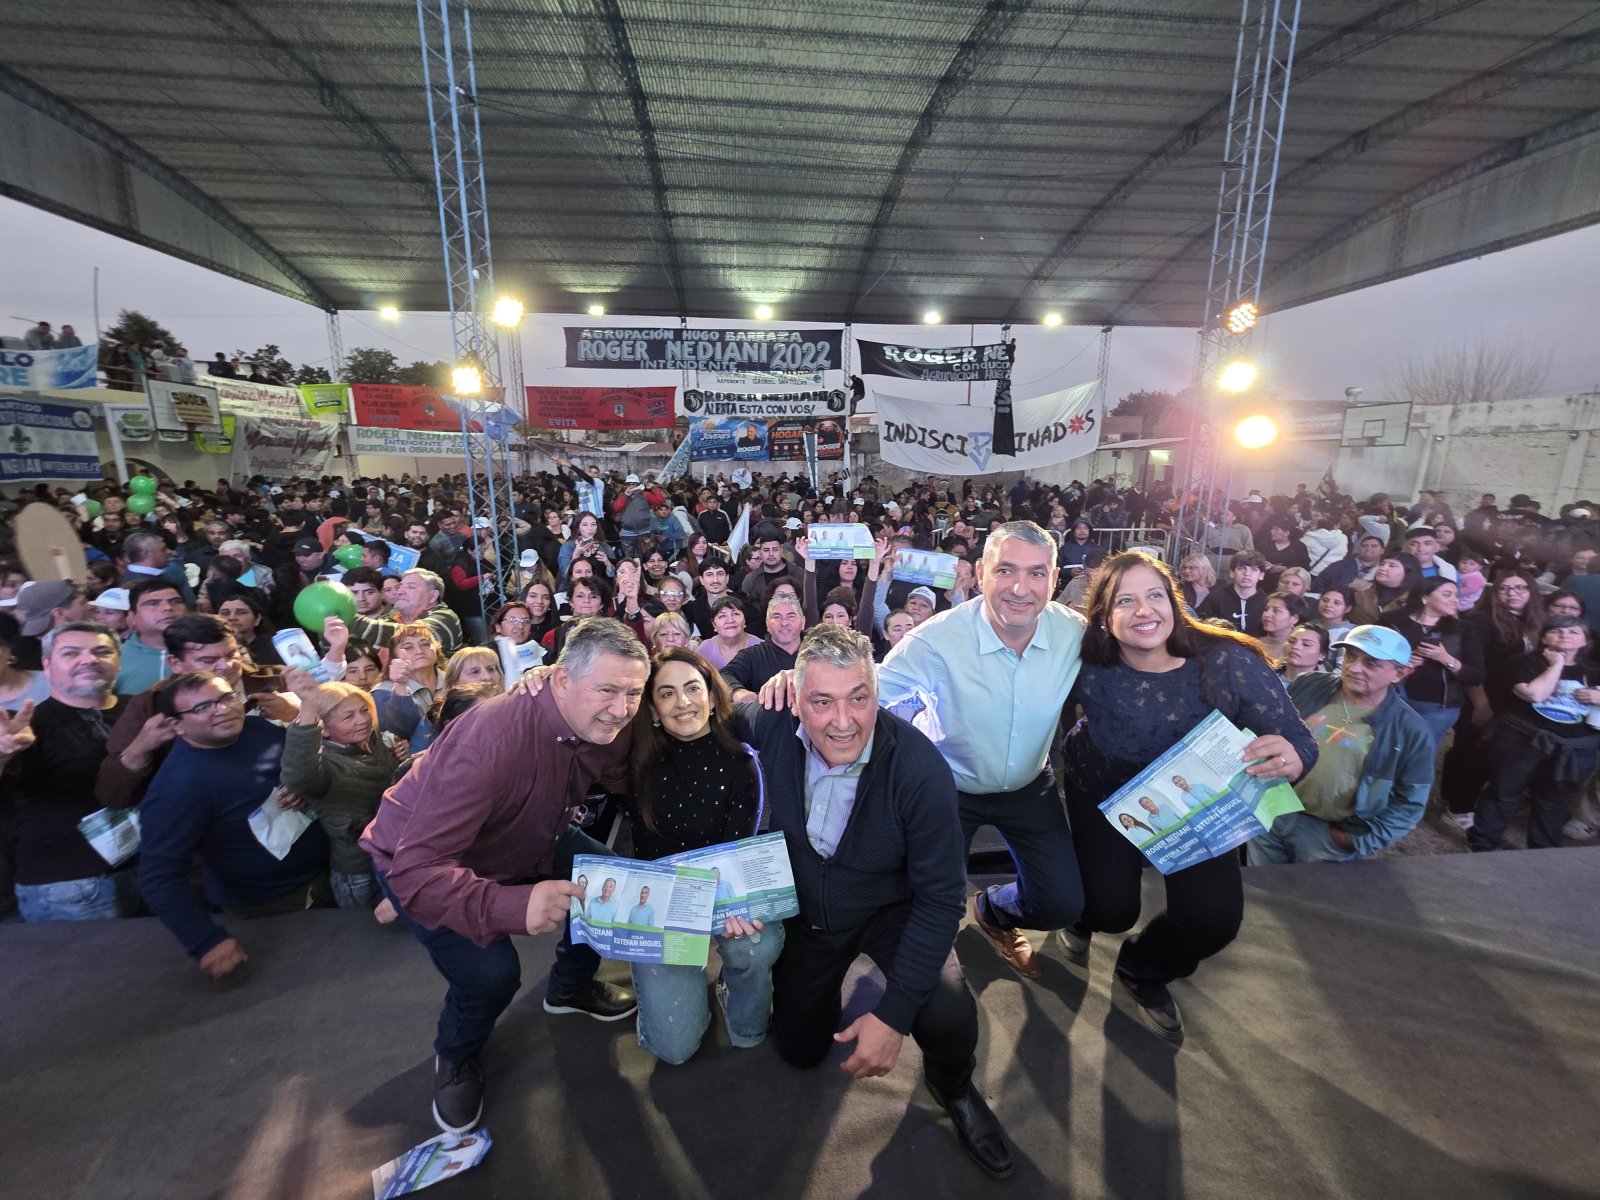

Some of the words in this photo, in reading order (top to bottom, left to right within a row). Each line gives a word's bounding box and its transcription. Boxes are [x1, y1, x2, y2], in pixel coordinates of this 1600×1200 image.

[682, 331, 720, 341] HUGO
[577, 340, 649, 361] ROGER
[665, 341, 767, 363] NEDIANI
[770, 341, 832, 371] 2022
[883, 345, 978, 364] ROGER
[640, 359, 738, 372] INTENDENTE
[739, 405, 763, 414] ESTA
[766, 405, 787, 414] CON
[790, 405, 816, 415] VOS!
[549, 418, 578, 427] EVITA
[356, 428, 399, 439] ROGER
[409, 446, 442, 454] OBRAS
[1218, 798, 1243, 818] MIGUEL
[1145, 839, 1169, 857] ROGER
[1167, 824, 1191, 844] NEDIANI
[613, 936, 639, 947] ESTEFAN
[639, 940, 663, 948] MIGUEL
